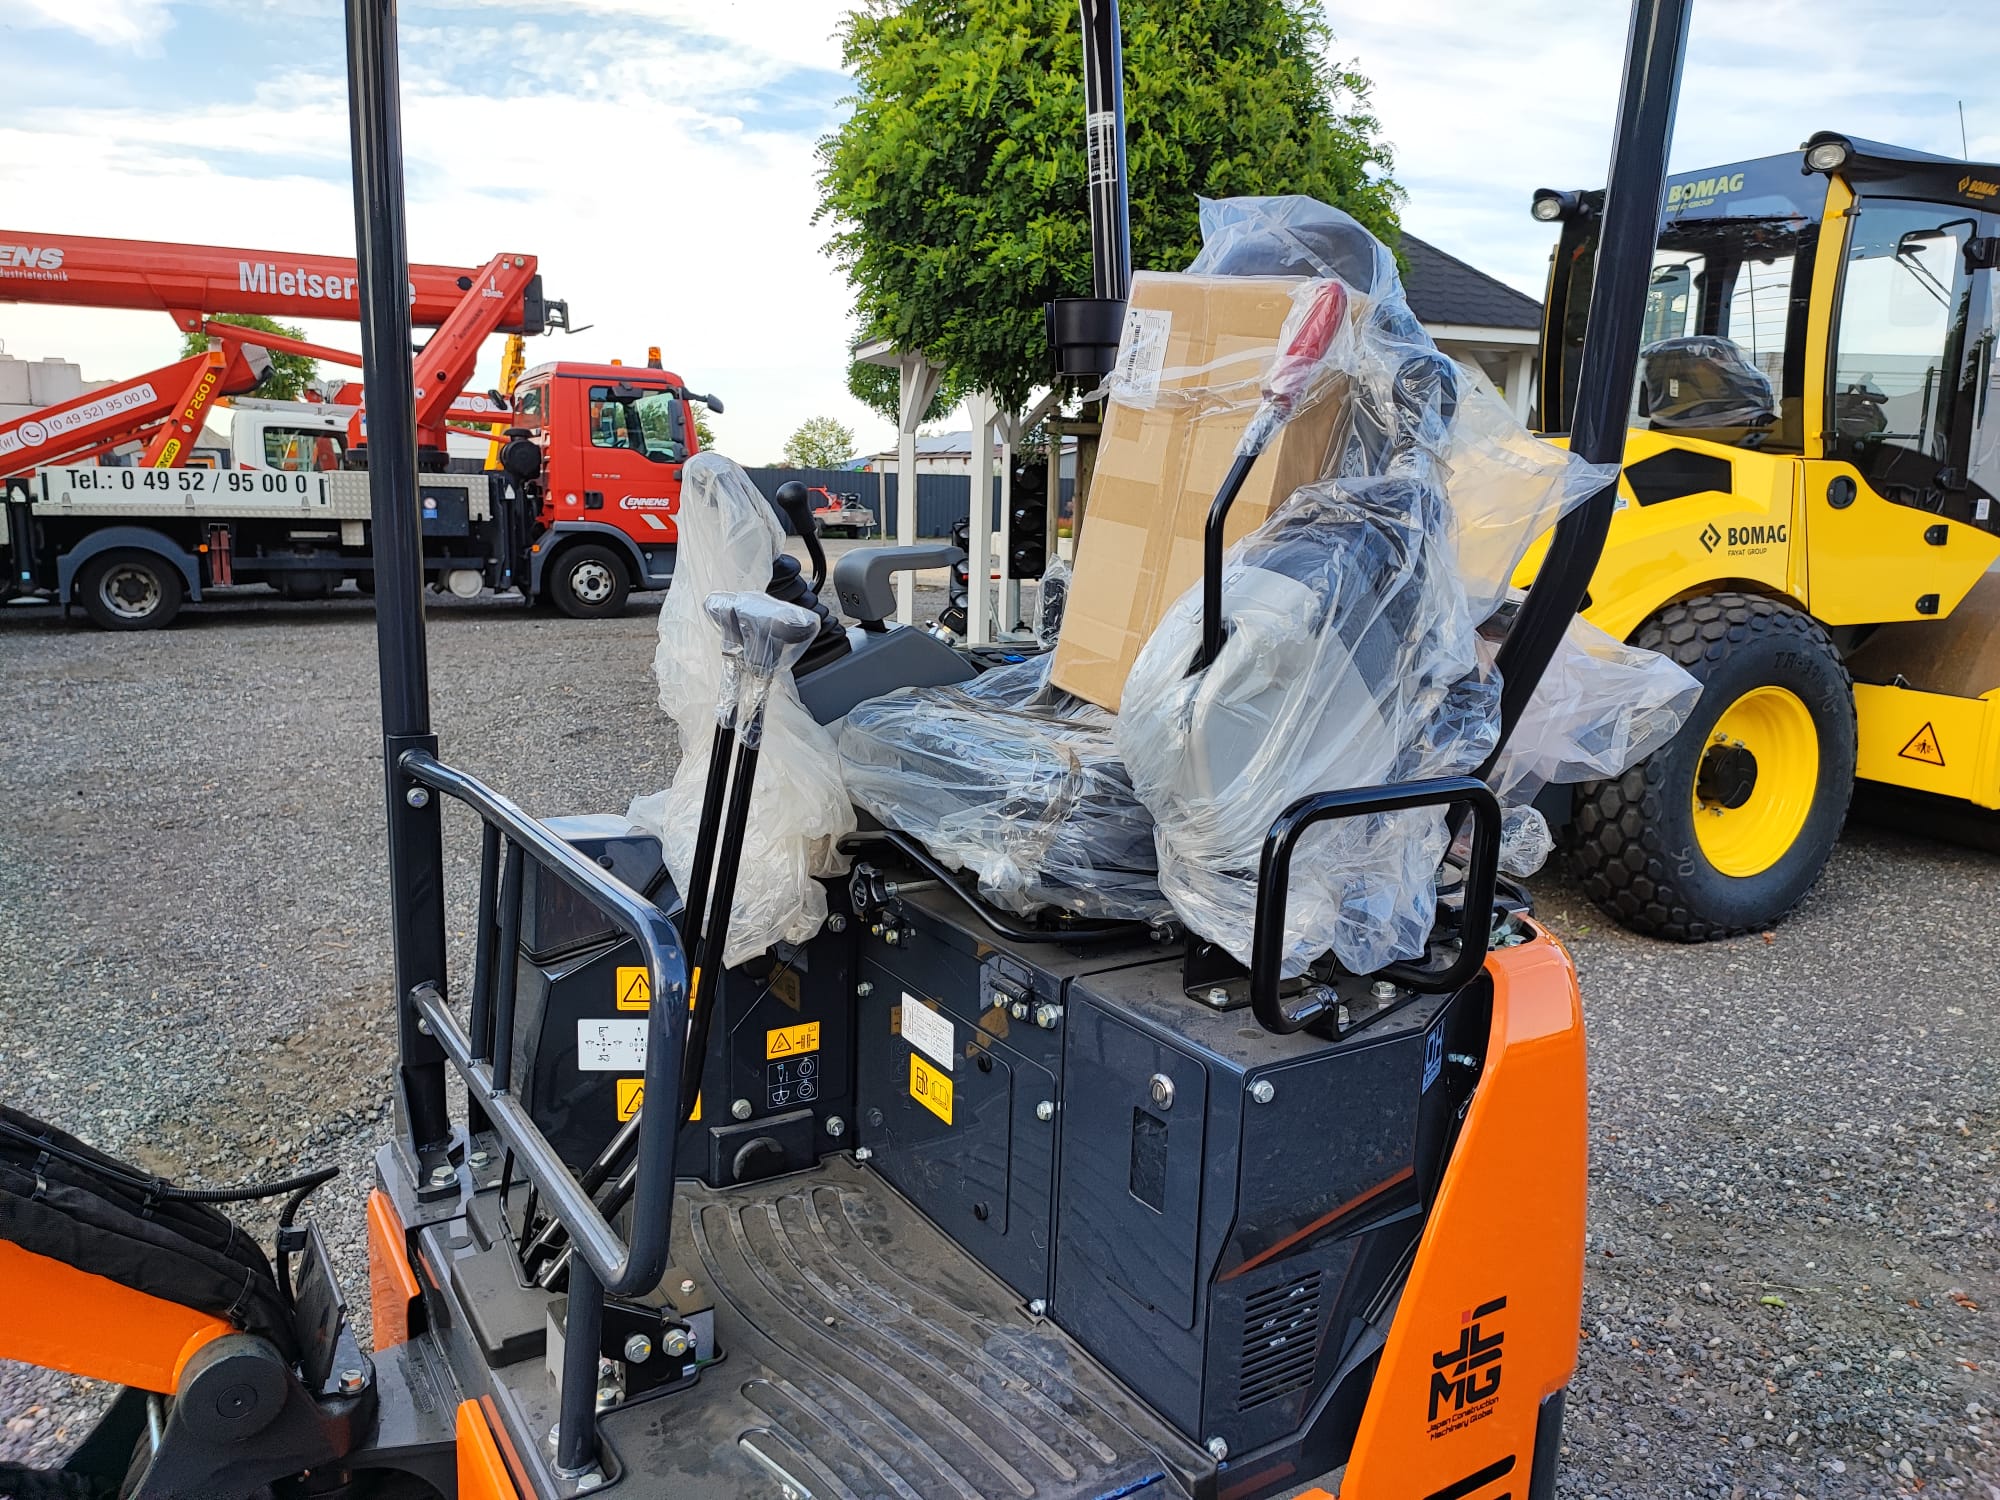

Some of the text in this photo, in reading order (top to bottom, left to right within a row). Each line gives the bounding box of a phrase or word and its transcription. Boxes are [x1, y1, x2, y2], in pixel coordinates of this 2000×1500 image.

[1668, 173, 1745, 204] BOMAG
[66, 413, 81, 425] 49
[105, 399, 123, 411] 95
[124, 392, 141, 405] 00
[142, 388, 151, 399] 0
[184, 372, 217, 420] P 260 B
[66, 469, 113, 489] Tel.:
[121, 470, 135, 490] 0
[143, 471, 170, 490] 49
[178, 472, 205, 491] 52
[228, 472, 254, 492] 95
[262, 473, 287, 493] 00
[295, 474, 307, 494] 0
[1727, 524, 1787, 546] BOMAG
[1727, 547, 1768, 557] FAYAT GROUP
[1426, 1396, 1499, 1434] Japan Construction
[1430, 1406, 1494, 1441] Machinery Global
